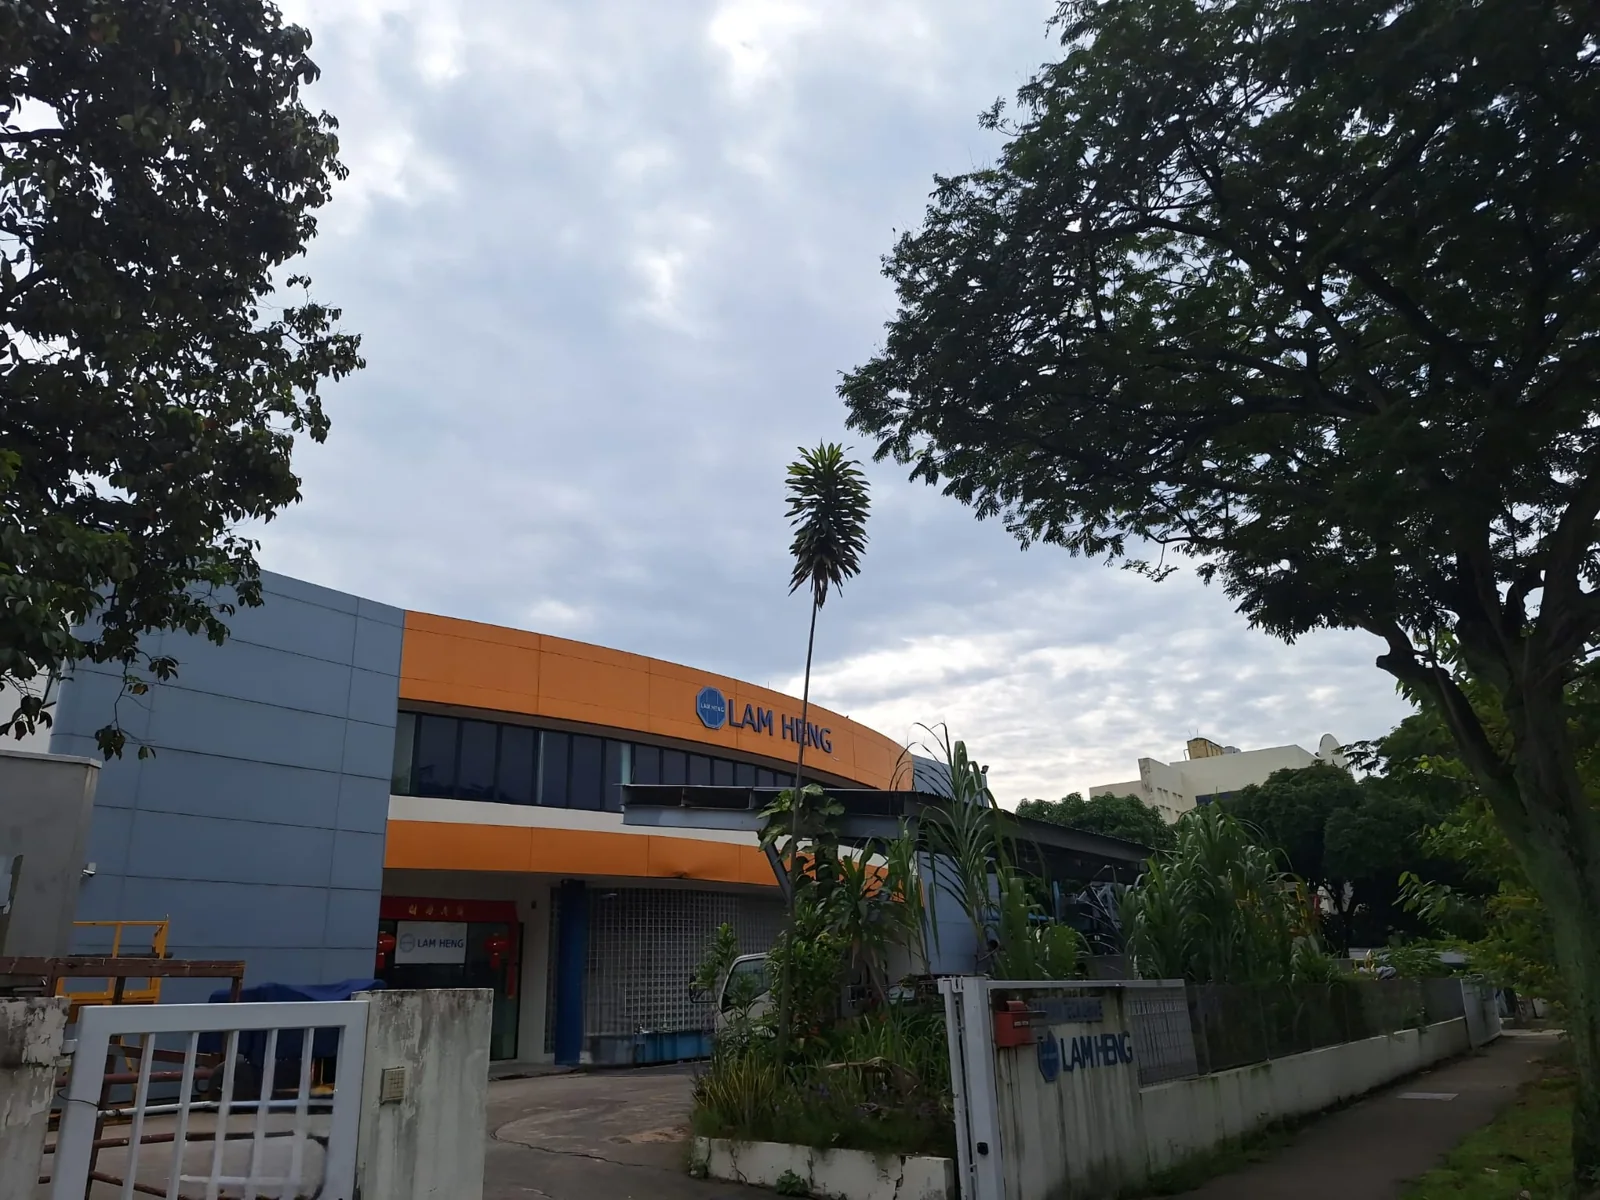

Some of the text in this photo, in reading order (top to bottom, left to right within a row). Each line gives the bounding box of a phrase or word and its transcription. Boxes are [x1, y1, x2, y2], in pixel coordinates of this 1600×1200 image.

[729, 699, 773, 736] LAM
[417, 939, 464, 948] LAM HENG
[1060, 1030, 1133, 1072] LAM HENG
